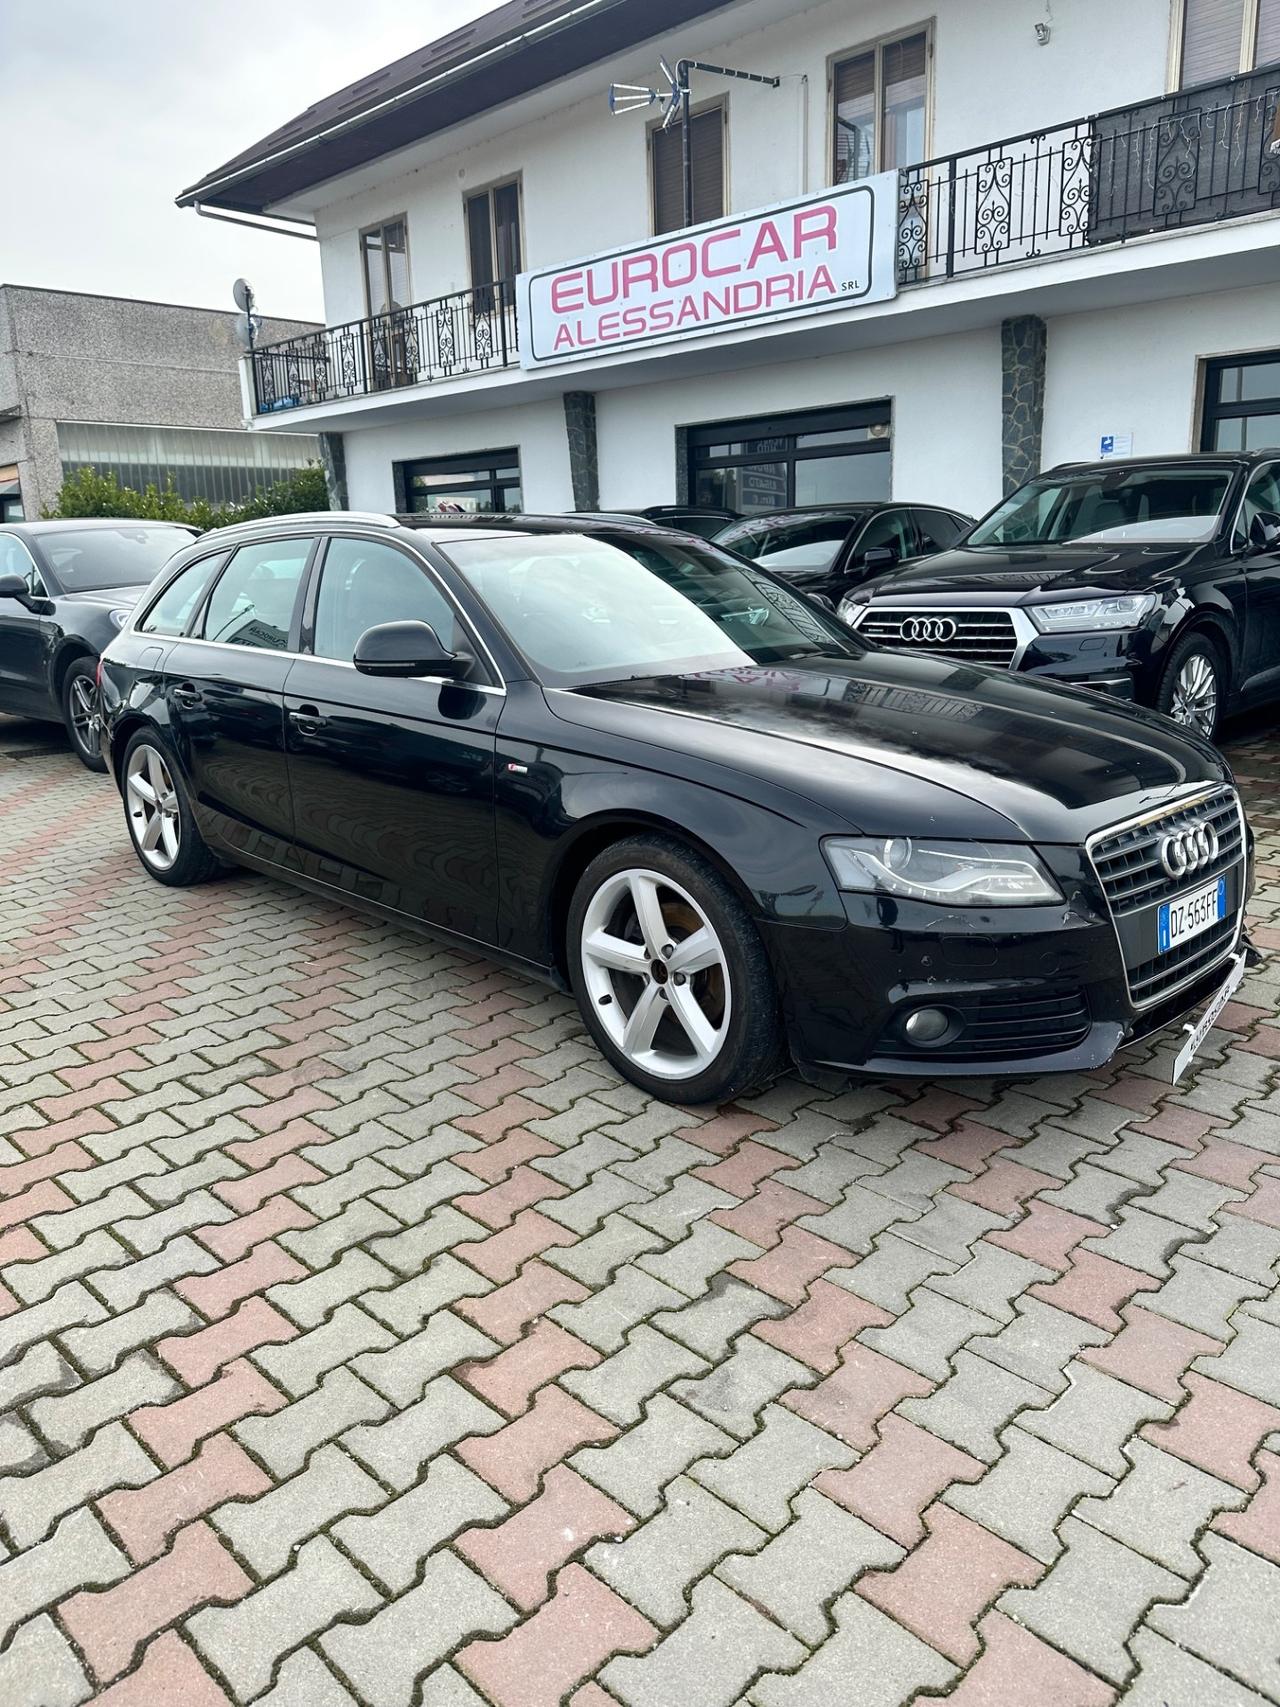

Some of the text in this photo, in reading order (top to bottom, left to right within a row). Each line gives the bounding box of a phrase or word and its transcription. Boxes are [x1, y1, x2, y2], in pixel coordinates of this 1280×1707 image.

[551, 205, 837, 314] EUROCAR
[553, 265, 860, 350] ALESSANDRIA SRL
